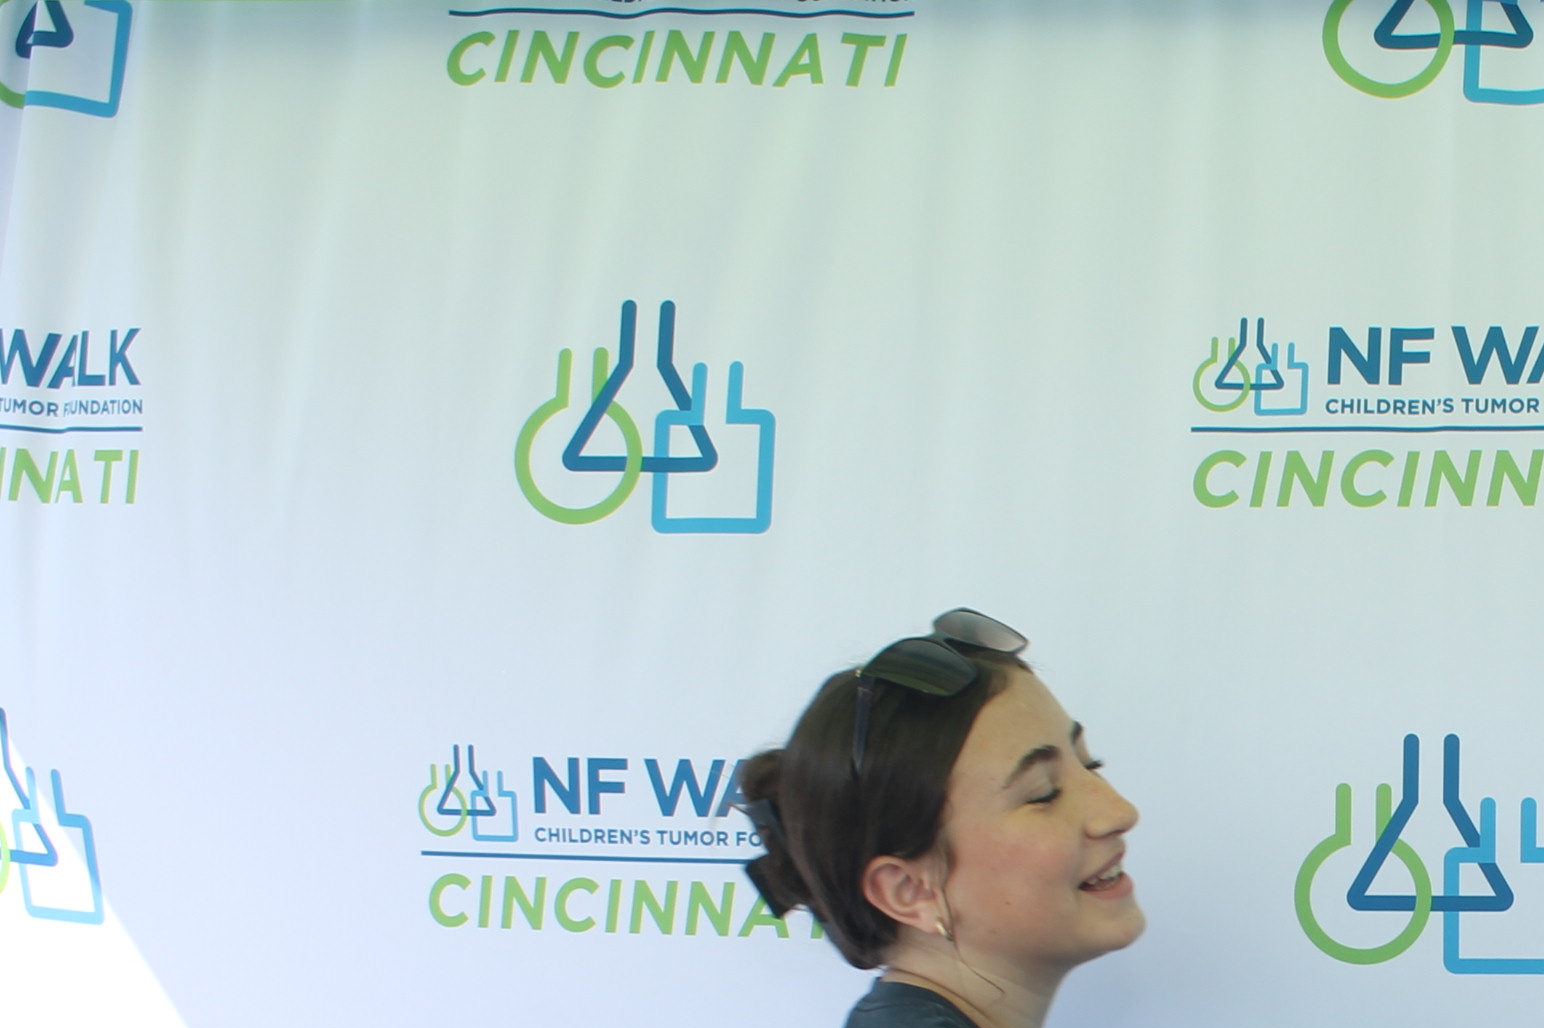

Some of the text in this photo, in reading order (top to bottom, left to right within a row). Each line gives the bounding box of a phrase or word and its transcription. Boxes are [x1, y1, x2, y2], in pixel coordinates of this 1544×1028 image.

[446, 29, 908, 89] CINCINNATI
[0, 328, 142, 389] WALK
[1326, 326, 1435, 385] NF
[1325, 397, 1455, 415] CHILDREN'S
[1461, 397, 1540, 414] TUMOR
[0, 447, 139, 504] NATI
[532, 756, 629, 816] NF
[534, 827, 651, 846] CHILDREN'S
[657, 830, 728, 847] TUMOR
[429, 873, 825, 939] CINCINNA
